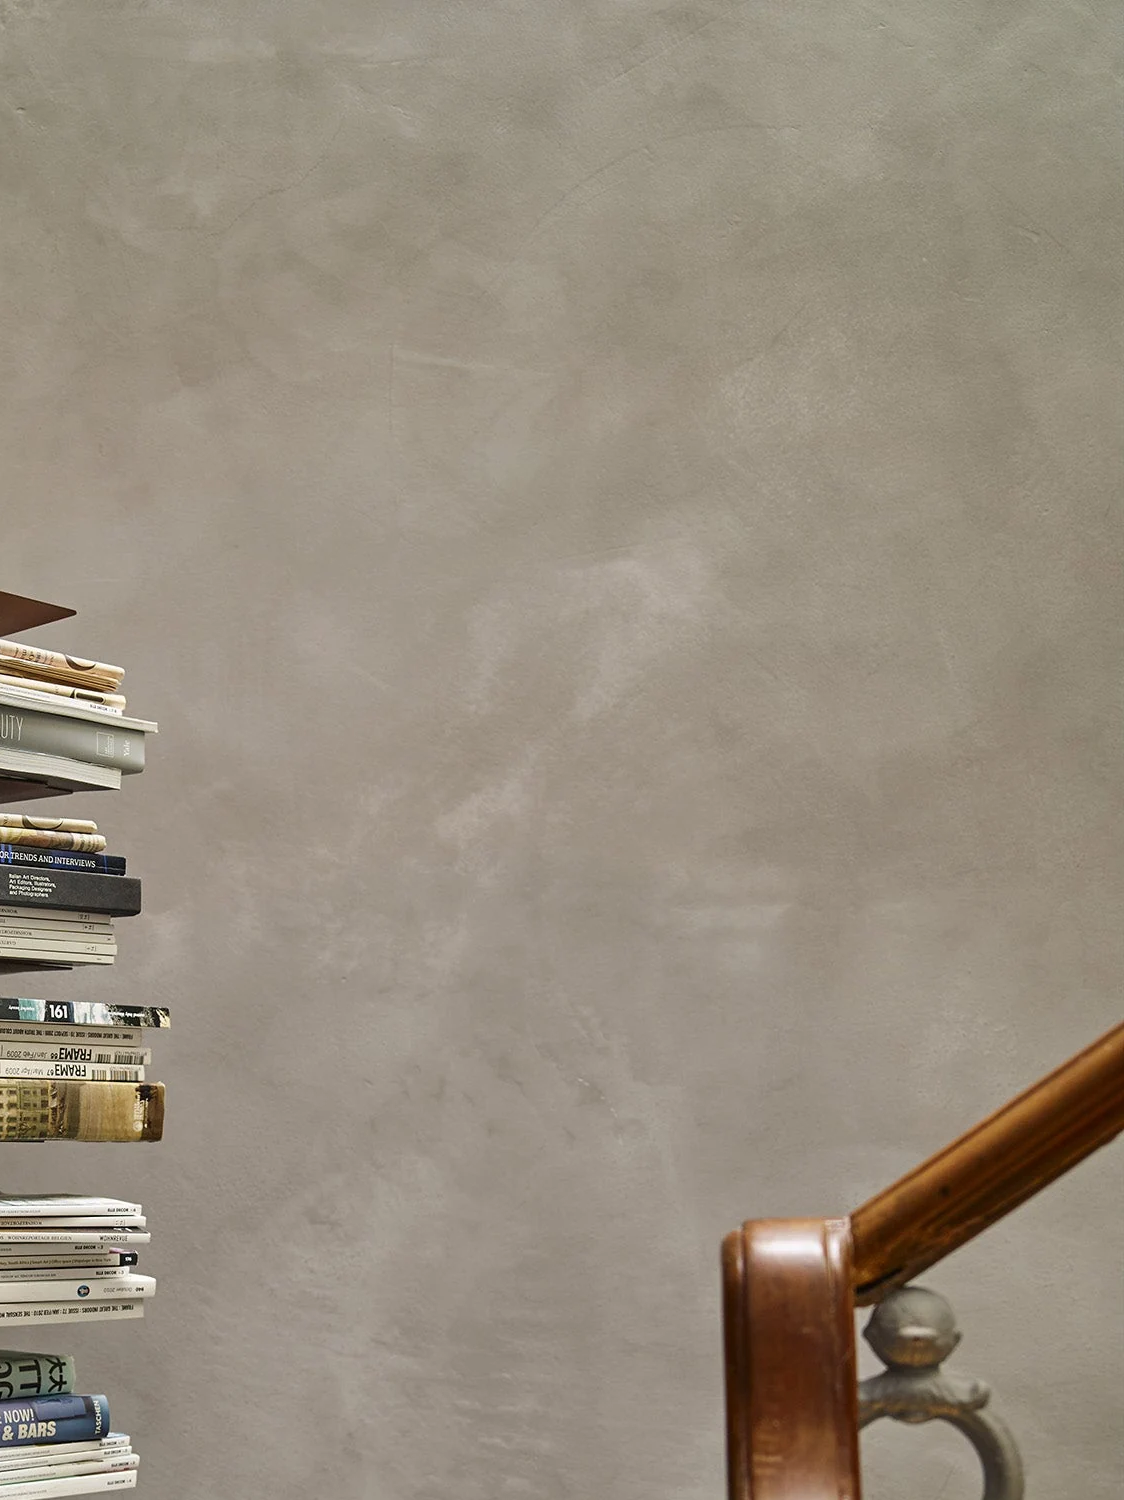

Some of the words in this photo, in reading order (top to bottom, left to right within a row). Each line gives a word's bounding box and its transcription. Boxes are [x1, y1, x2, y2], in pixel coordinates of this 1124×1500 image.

[11, 851, 37, 862] TRENDS
[37, 853, 54, 863] AND
[54, 855, 95, 867] INTERVIEWS
[8, 884, 31, 892] Packaging
[31, 885, 52, 893] Designers
[18, 890, 49, 898] Photographers
[49, 1004, 68, 1019] 161
[6, 1050, 22, 1058] 2009
[4, 1407, 34, 1424] NOW!
[94, 1400, 102, 1434] TASCHEN
[1, 1424, 14, 1442] &
[17, 1420, 56, 1440] BARS
